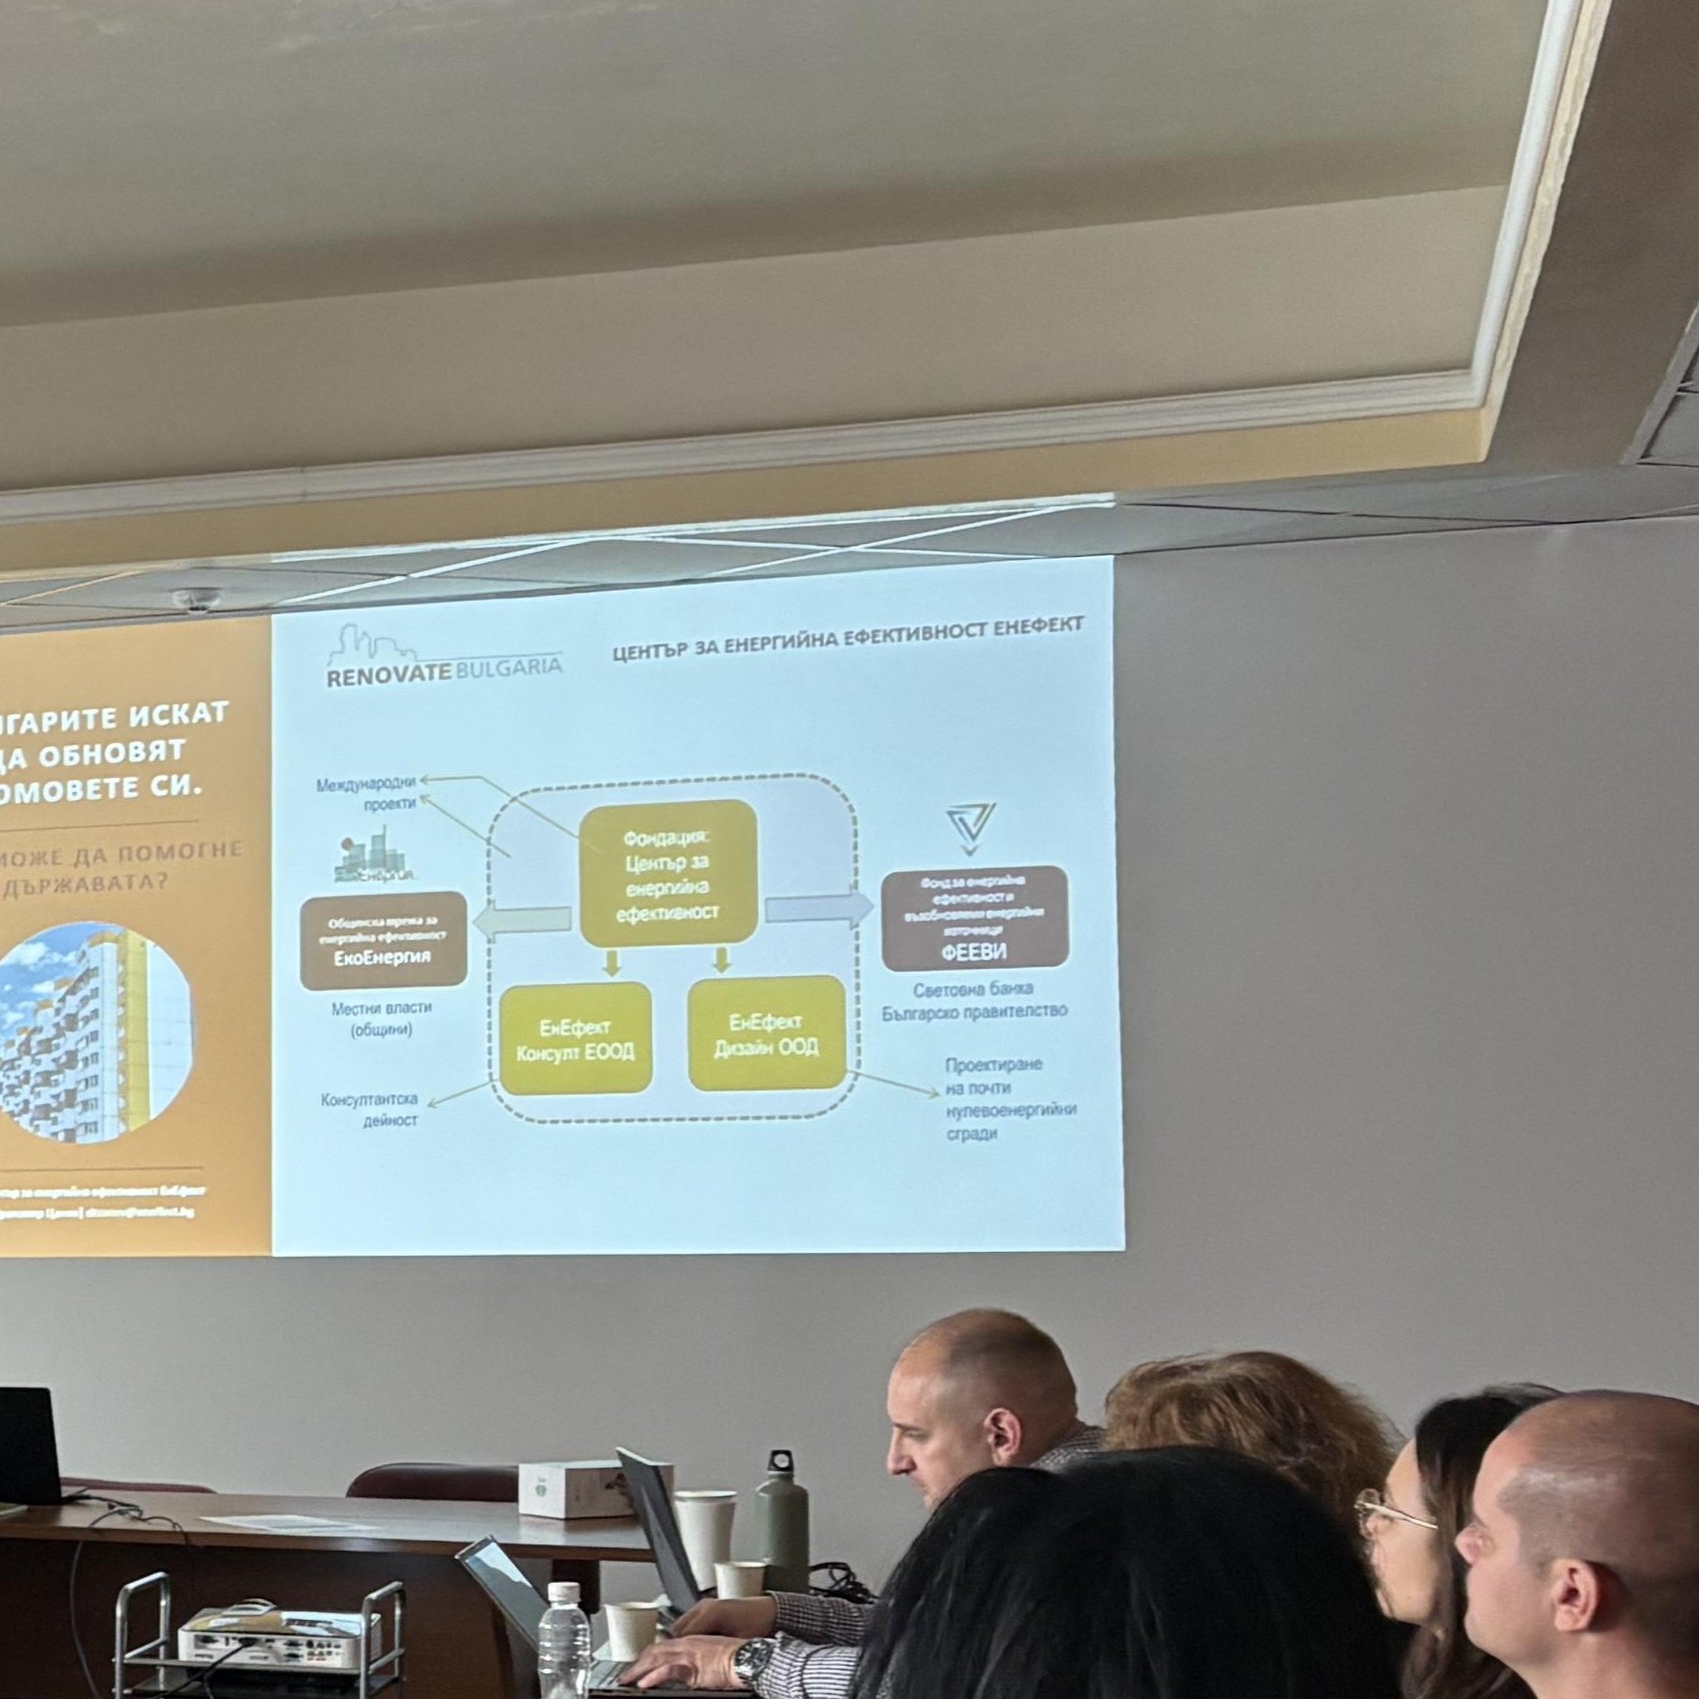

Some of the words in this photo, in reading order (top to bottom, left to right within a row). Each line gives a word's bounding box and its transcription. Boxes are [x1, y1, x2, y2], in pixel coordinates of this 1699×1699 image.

[613, 642, 688, 663] ЦЕНТЪР
[695, 640, 720, 655] ЗА
[724, 630, 838, 653] ЕНЕРГИЙНА
[844, 622, 988, 646] ЕФЕКТИВНОСТ
[994, 615, 1085, 636] ЕНЕФЕКТ
[327, 663, 451, 688] RENOVATE
[456, 657, 563, 679] BULGARIA
[129, 701, 229, 727] ИСКАТ
[38, 738, 186, 768] ОБНОВЯТ
[151, 773, 202, 797] СИ.
[316, 776, 416, 794] Международни
[364, 798, 416, 814] проекти
[73, 848, 107, 869] ДА
[118, 840, 243, 863] ПОМОГНЕ
[626, 855, 687, 875] Център
[691, 855, 710, 869] за
[2, 872, 168, 900] ДЪРЖАВАТА?
[626, 878, 709, 899] енергийна
[616, 905, 720, 925] ефективност
[334, 949, 431, 967] ЕкоЕнергия
[942, 942, 1007, 961] ФЕЕВИ
[913, 982, 985, 998] Световна
[989, 980, 1034, 996] банка
[332, 1002, 381, 1016] Местни
[386, 1001, 432, 1015] власти
[882, 1006, 959, 1023] Българско
[964, 1004, 1068, 1023] правителство
[351, 1021, 413, 1039] (общини)
[540, 1018, 611, 1039] ЕнЕфект
[729, 1013, 803, 1032] ЕнЕфект
[585, 1042, 635, 1062] ЕООД
[714, 1039, 774, 1060] Дизайн
[779, 1037, 820, 1057] ООД
[945, 1057, 1043, 1075] Проектиране
[946, 1083, 964, 1096] на
[969, 1082, 1012, 1096] почти
[321, 1093, 419, 1110] Консултантска
[946, 1101, 1077, 1121] нулевоенергийни
[363, 1114, 419, 1129] дейност
[947, 1128, 998, 1143] сгради
